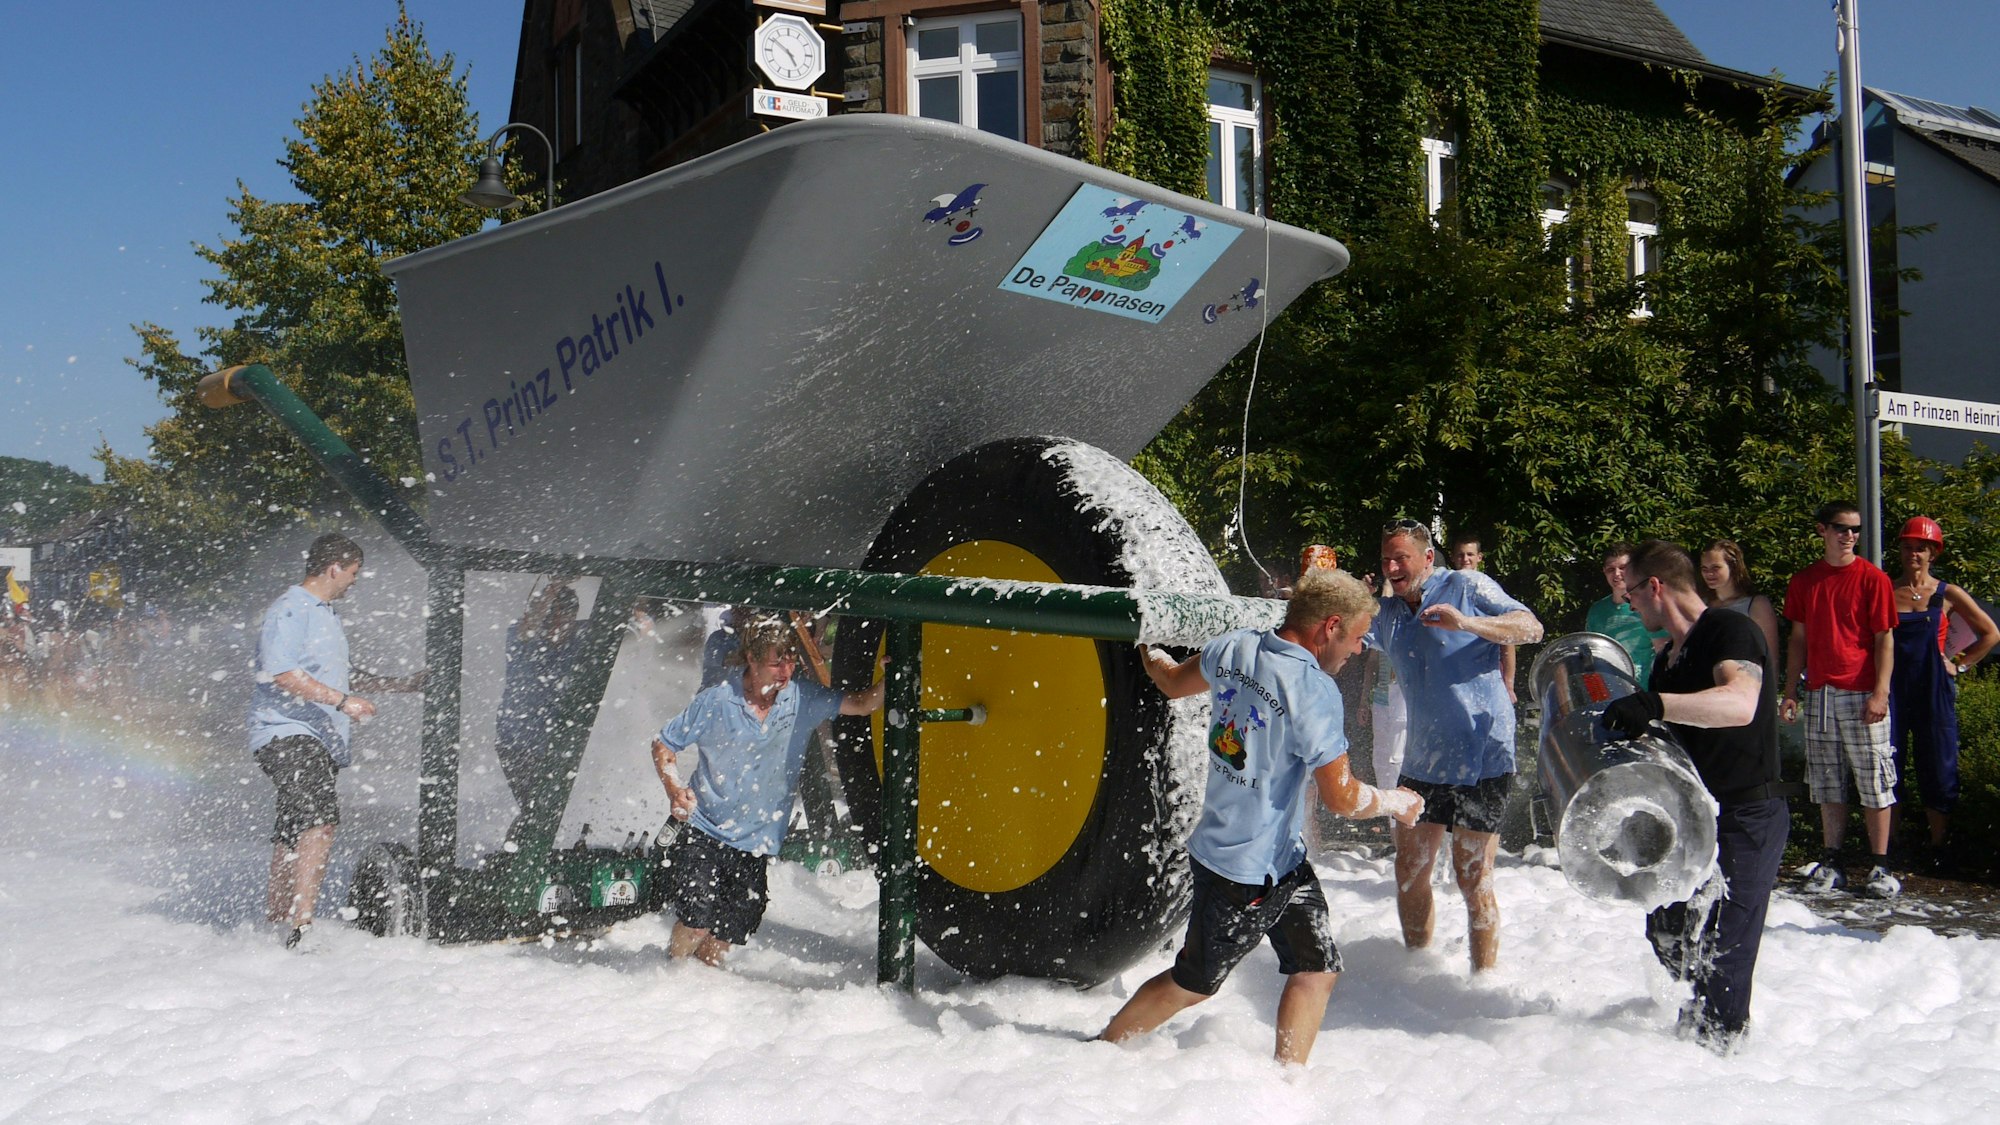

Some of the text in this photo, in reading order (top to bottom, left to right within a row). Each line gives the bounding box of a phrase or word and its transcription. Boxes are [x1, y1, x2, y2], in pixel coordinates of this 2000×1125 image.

[782, 105, 815, 114] AUTOMAT
[1011, 266, 1166, 317] De Pappnasen
[437, 261, 684, 482] S.T. Prinz Patrik I.
[1888, 398, 1907, 416] Am
[1913, 401, 1959, 422] Prinzen
[1215, 666, 1286, 717] De Pappnasen
